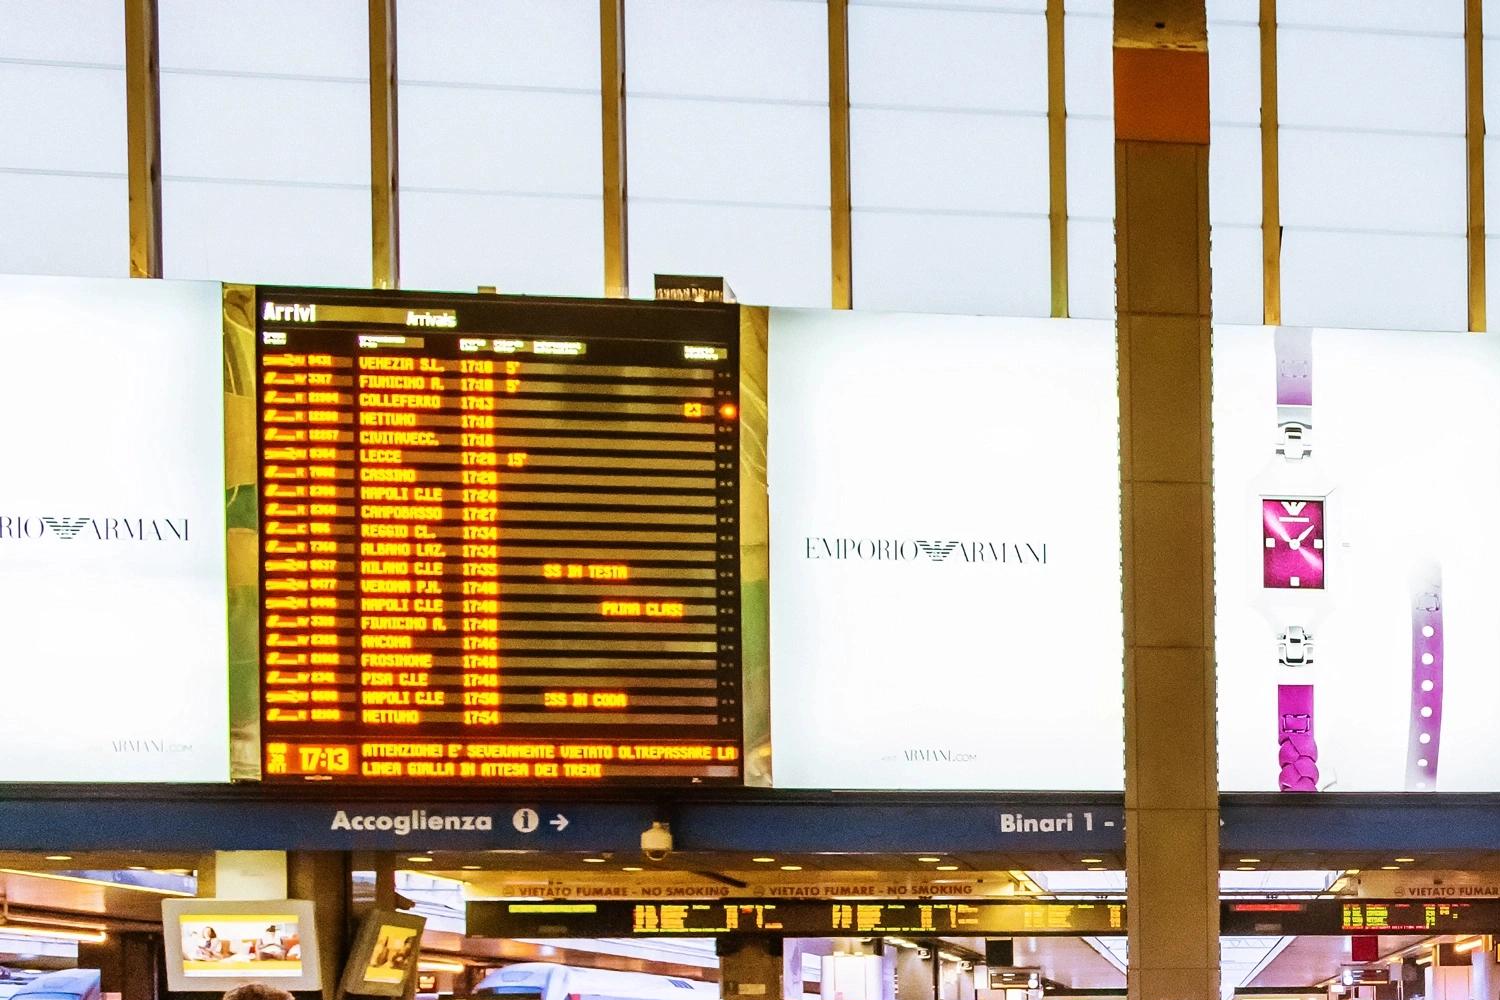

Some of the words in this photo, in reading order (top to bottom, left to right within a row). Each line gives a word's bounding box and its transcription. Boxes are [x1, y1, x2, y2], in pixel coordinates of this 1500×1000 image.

[263, 302, 316, 322] Arrivi
[406, 311, 457, 327] Arrivals
[91, 517, 189, 542] ARMANI
[805, 536, 919, 561] EMPORIO
[960, 541, 1047, 564] ARMANI
[298, 747, 349, 771] 17:13
[716, 747, 735, 760] LA
[331, 810, 492, 835] Accoglienza
[1000, 812, 1073, 833] Binari
[1083, 813, 1093, 831] 1
[519, 887, 572, 897] VIETATO
[576, 887, 628, 897] FUMARE
[641, 886, 662, 897] NO
[666, 886, 730, 896] SMOKING
[769, 886, 820, 897] VIETATO
[824, 886, 875, 896] FUMARE
[887, 886, 908, 896] NO
[911, 885, 973, 895] SMOKING
[1408, 887, 1455, 896] VIETATO
